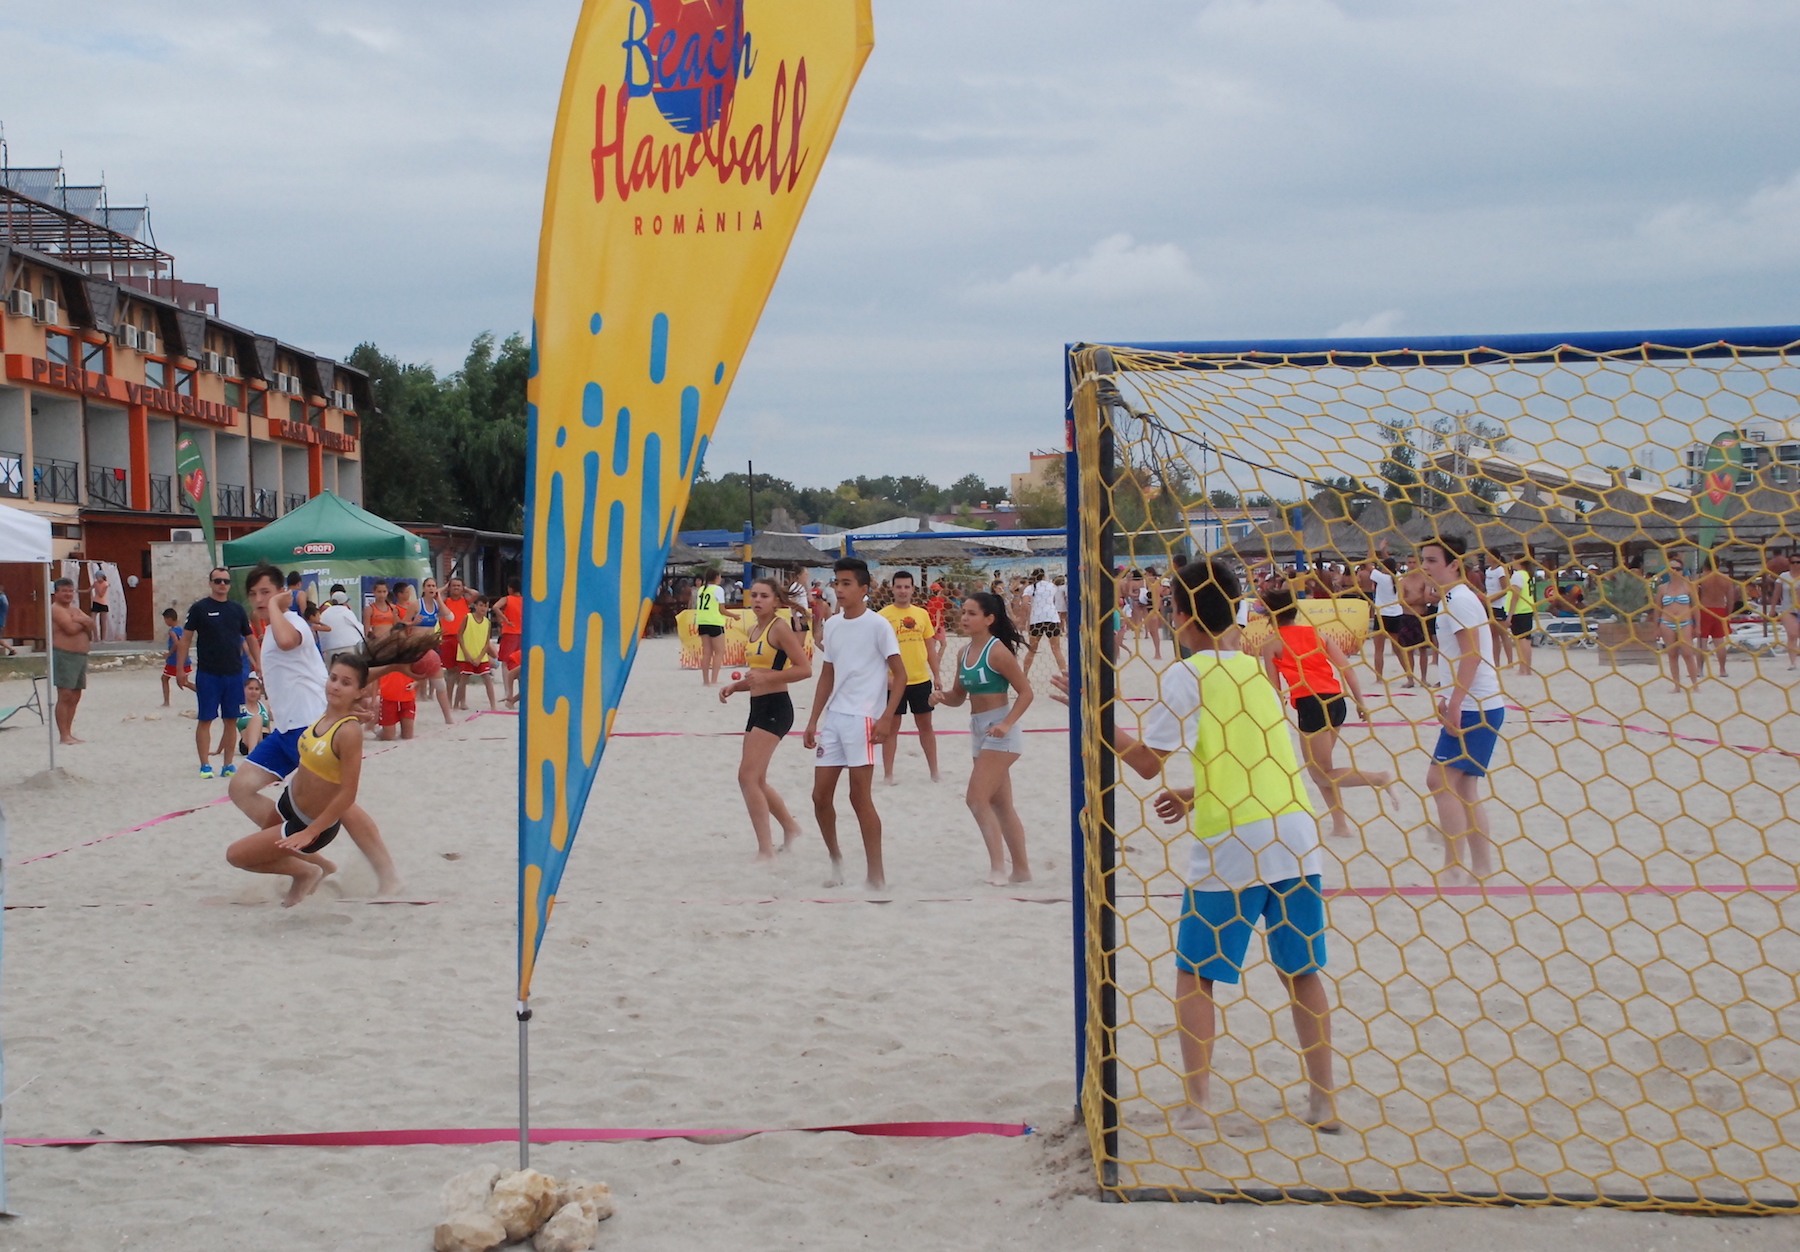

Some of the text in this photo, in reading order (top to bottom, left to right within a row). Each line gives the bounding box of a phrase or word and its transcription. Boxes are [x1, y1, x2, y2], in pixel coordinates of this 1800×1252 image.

[621, 0, 758, 98] Beach
[591, 56, 809, 204] Handball
[634, 208, 763, 236] ROMÂNIA
[32, 357, 234, 427] PERLA VENUSULUI
[281, 419, 309, 442] CASA
[307, 544, 332, 552] PROFI
[698, 593, 711, 610] 12
[756, 640, 763, 655] 1
[977, 667, 990, 685] 1
[312, 739, 327, 756] 12
